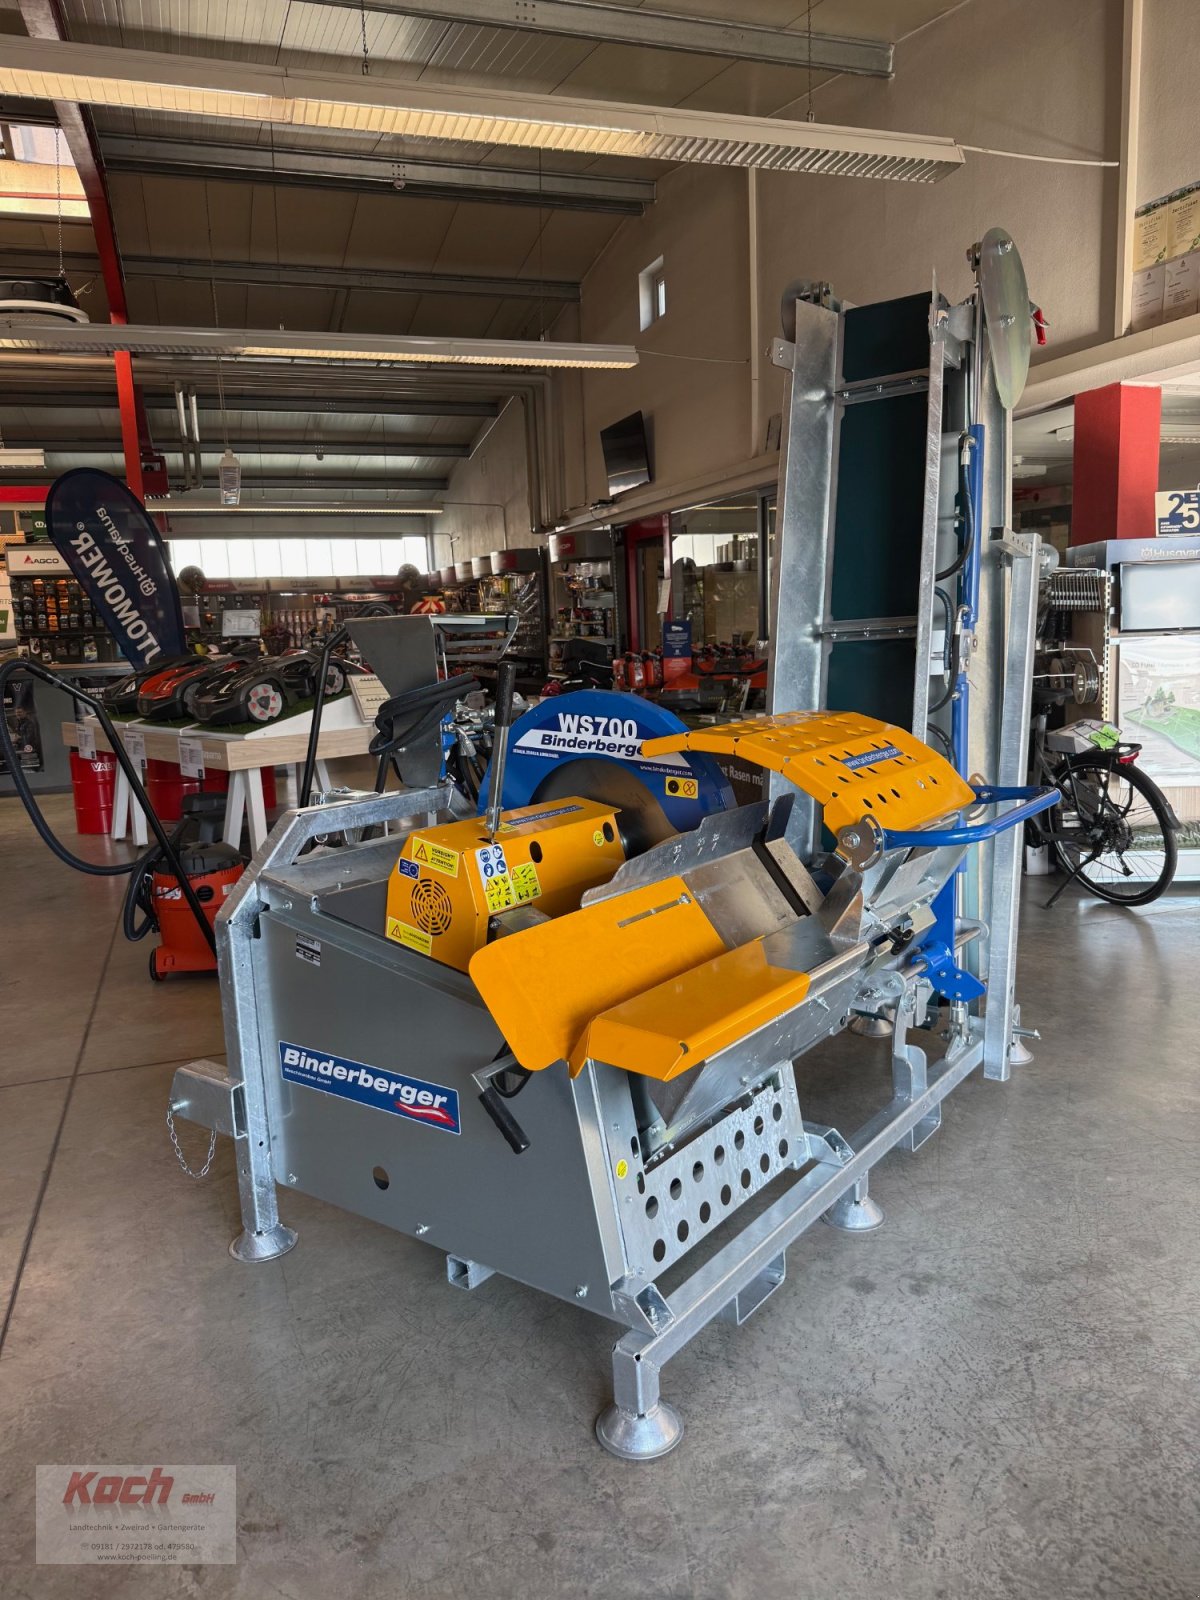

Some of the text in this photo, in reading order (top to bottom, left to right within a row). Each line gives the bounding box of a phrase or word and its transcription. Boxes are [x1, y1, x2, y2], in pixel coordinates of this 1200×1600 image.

[558, 712, 638, 740] WS700
[540, 734, 644, 757] Binderberge
[729, 765, 751, 783] Rasen
[283, 1047, 448, 1109] Binderberger
